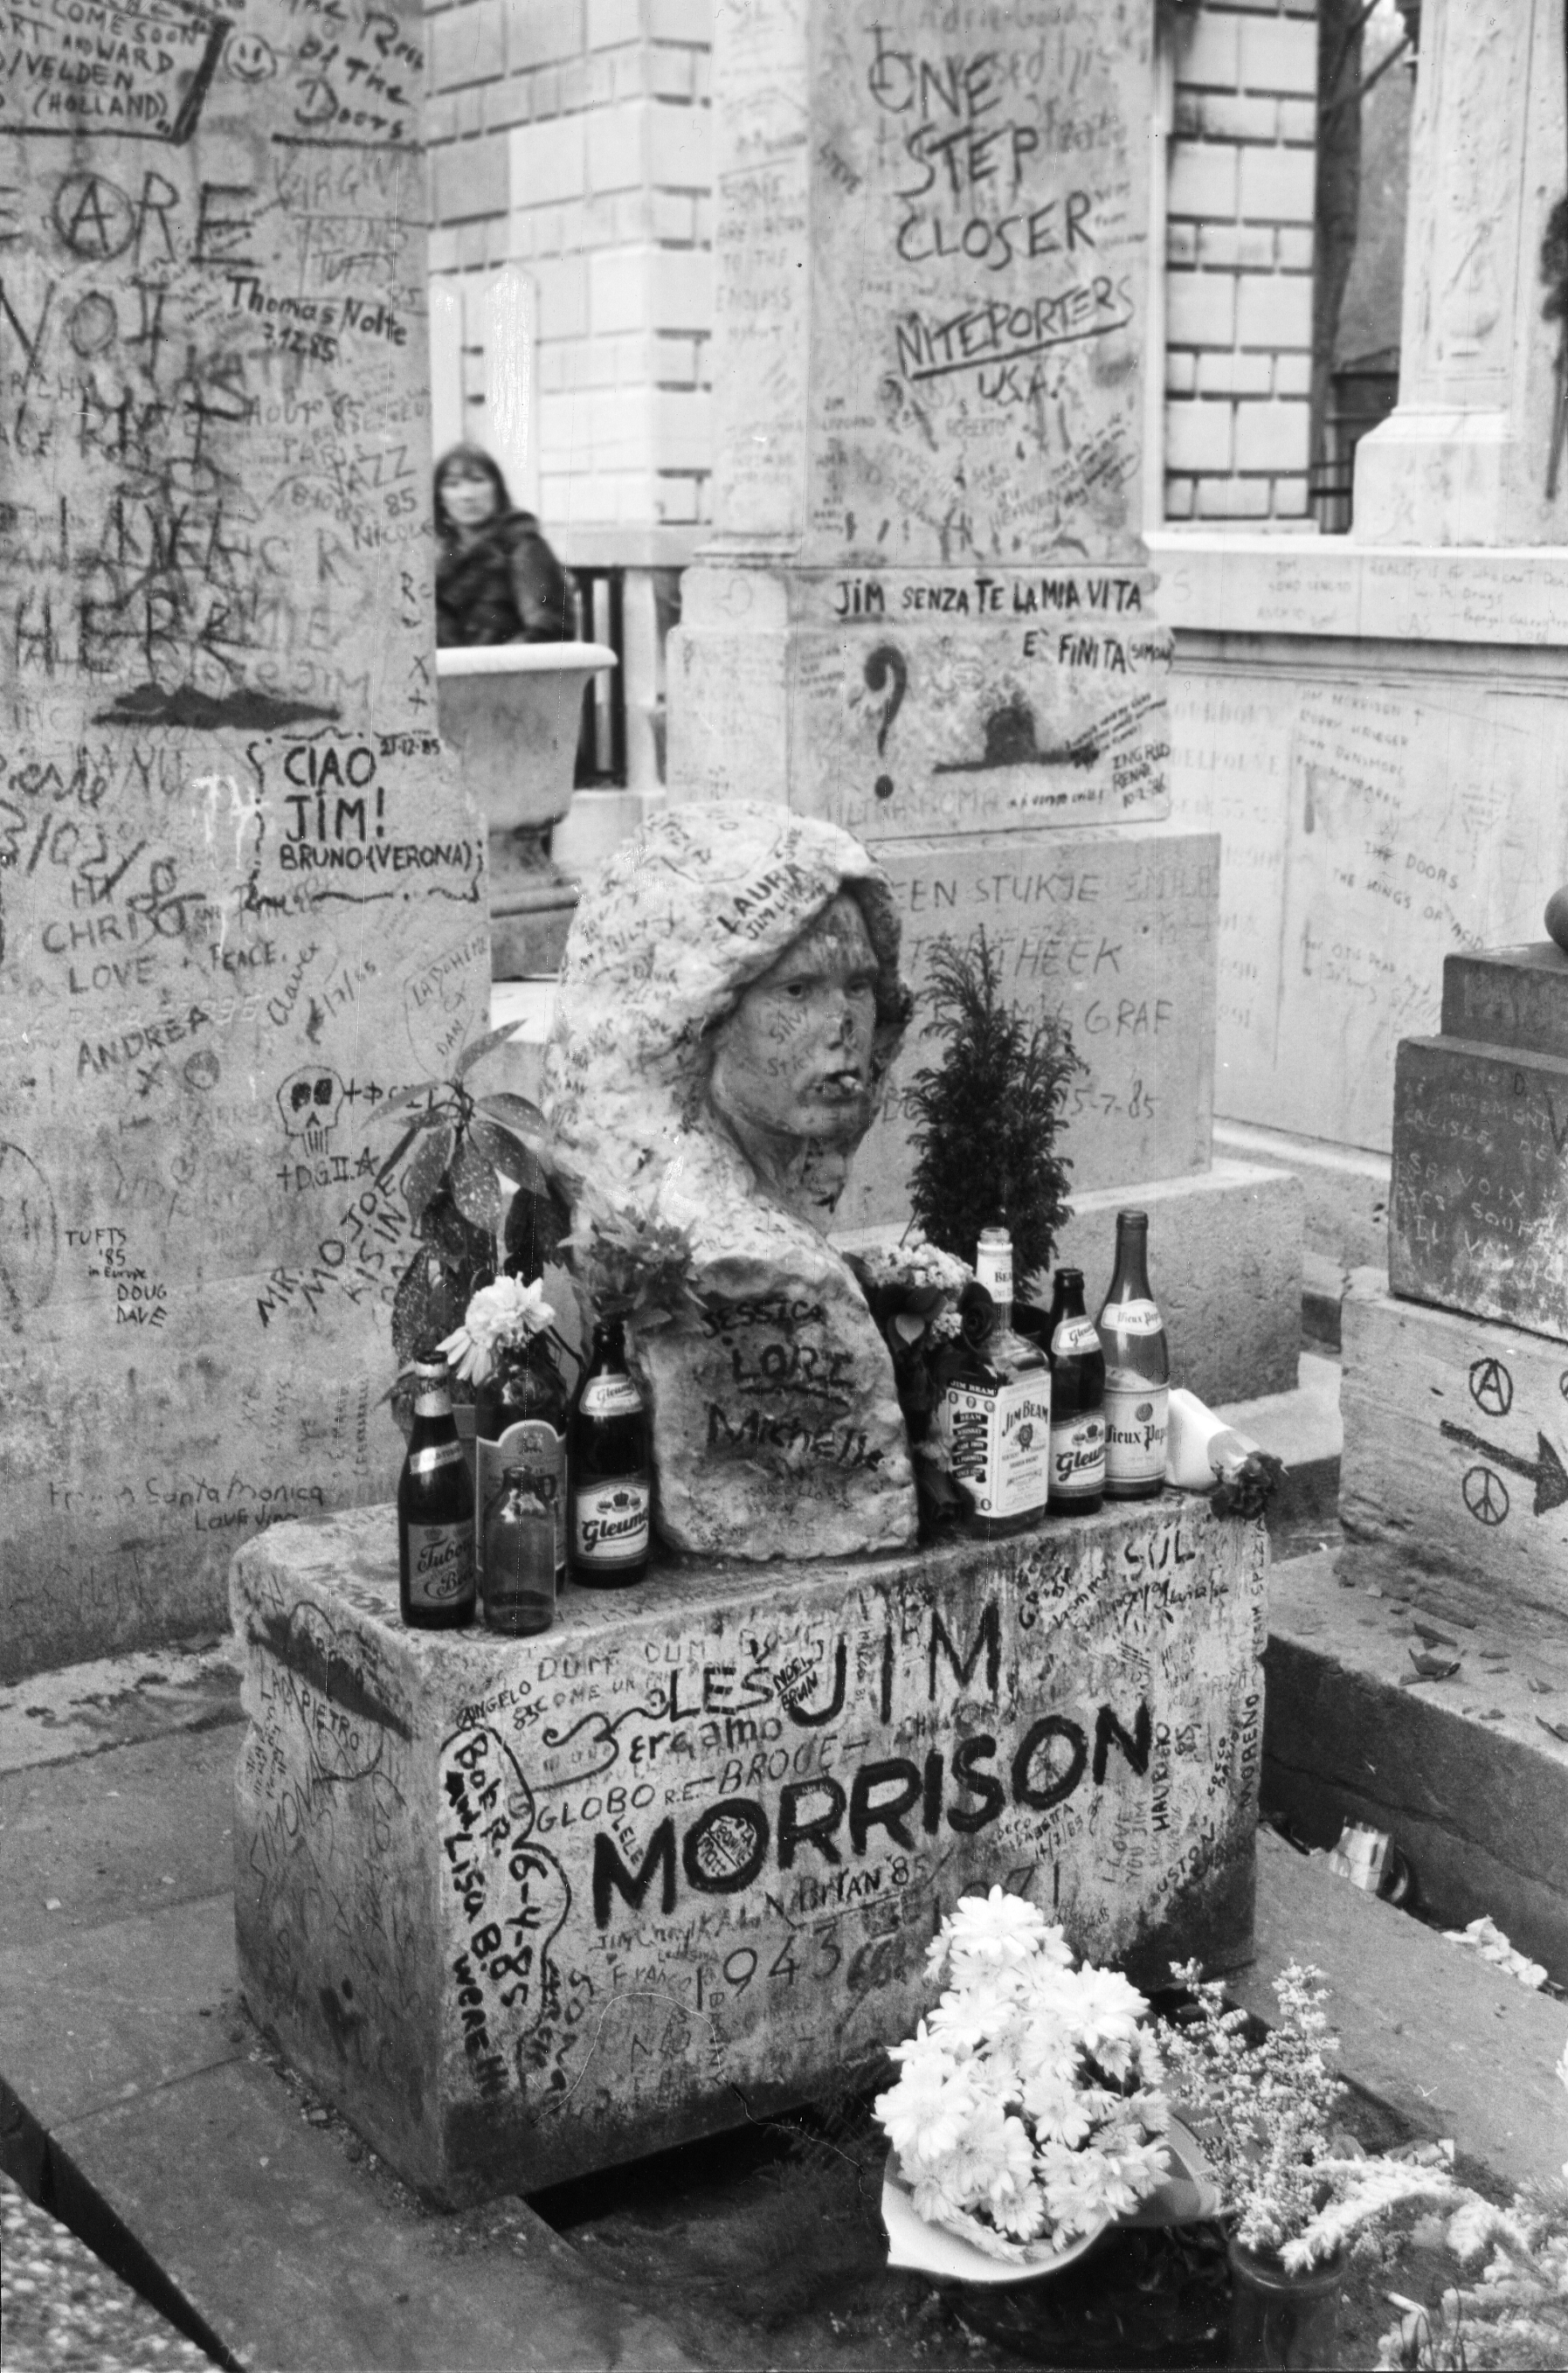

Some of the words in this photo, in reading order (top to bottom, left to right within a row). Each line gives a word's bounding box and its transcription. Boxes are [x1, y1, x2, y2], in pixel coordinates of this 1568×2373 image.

[893, 121, 1040, 199] STEP
[896, 190, 1096, 271] CLOSER
[225, 273, 337, 326] Thomas
[339, 295, 408, 347] Nolte
[836, 580, 886, 615] JIM
[902, 586, 969, 614] SENZA
[974, 578, 1005, 614] TE
[1013, 582, 1038, 613] LA
[1040, 579, 1081, 613] MIA
[1088, 578, 1143, 614] VITA
[1059, 633, 1127, 675] FINITA
[284, 745, 377, 788] CIAO
[285, 786, 385, 843] JIM!
[280, 844, 363, 872] BRUNO
[363, 841, 474, 875] (VERONA)
[1406, 851, 1460, 890] DOORS
[716, 862, 807, 935] LAURA
[69, 954, 157, 995] LOVE
[1085, 999, 1173, 1037] GRAF
[56, 1227, 127, 1247] TUFTS
[99, 1248, 127, 1267] '85
[116, 1282, 168, 1303] DOUG
[995, 1271, 1012, 1283] BEA
[115, 1304, 169, 1329] DAVE
[731, 1343, 856, 1389] LORI
[950, 1380, 967, 1390] JIM
[968, 1383, 996, 1396] BEAM
[1002, 1407, 1022, 1438] JIM
[1023, 1400, 1049, 1425] BEAM
[146, 1473, 219, 1506] Santa
[667, 1665, 775, 1723] LES
[784, 1601, 1003, 1728] JIM
[300, 1687, 360, 1753] PIETRO
[535, 1782, 656, 1834] GLOBO
[593, 1702, 1150, 1933] MORRISON
